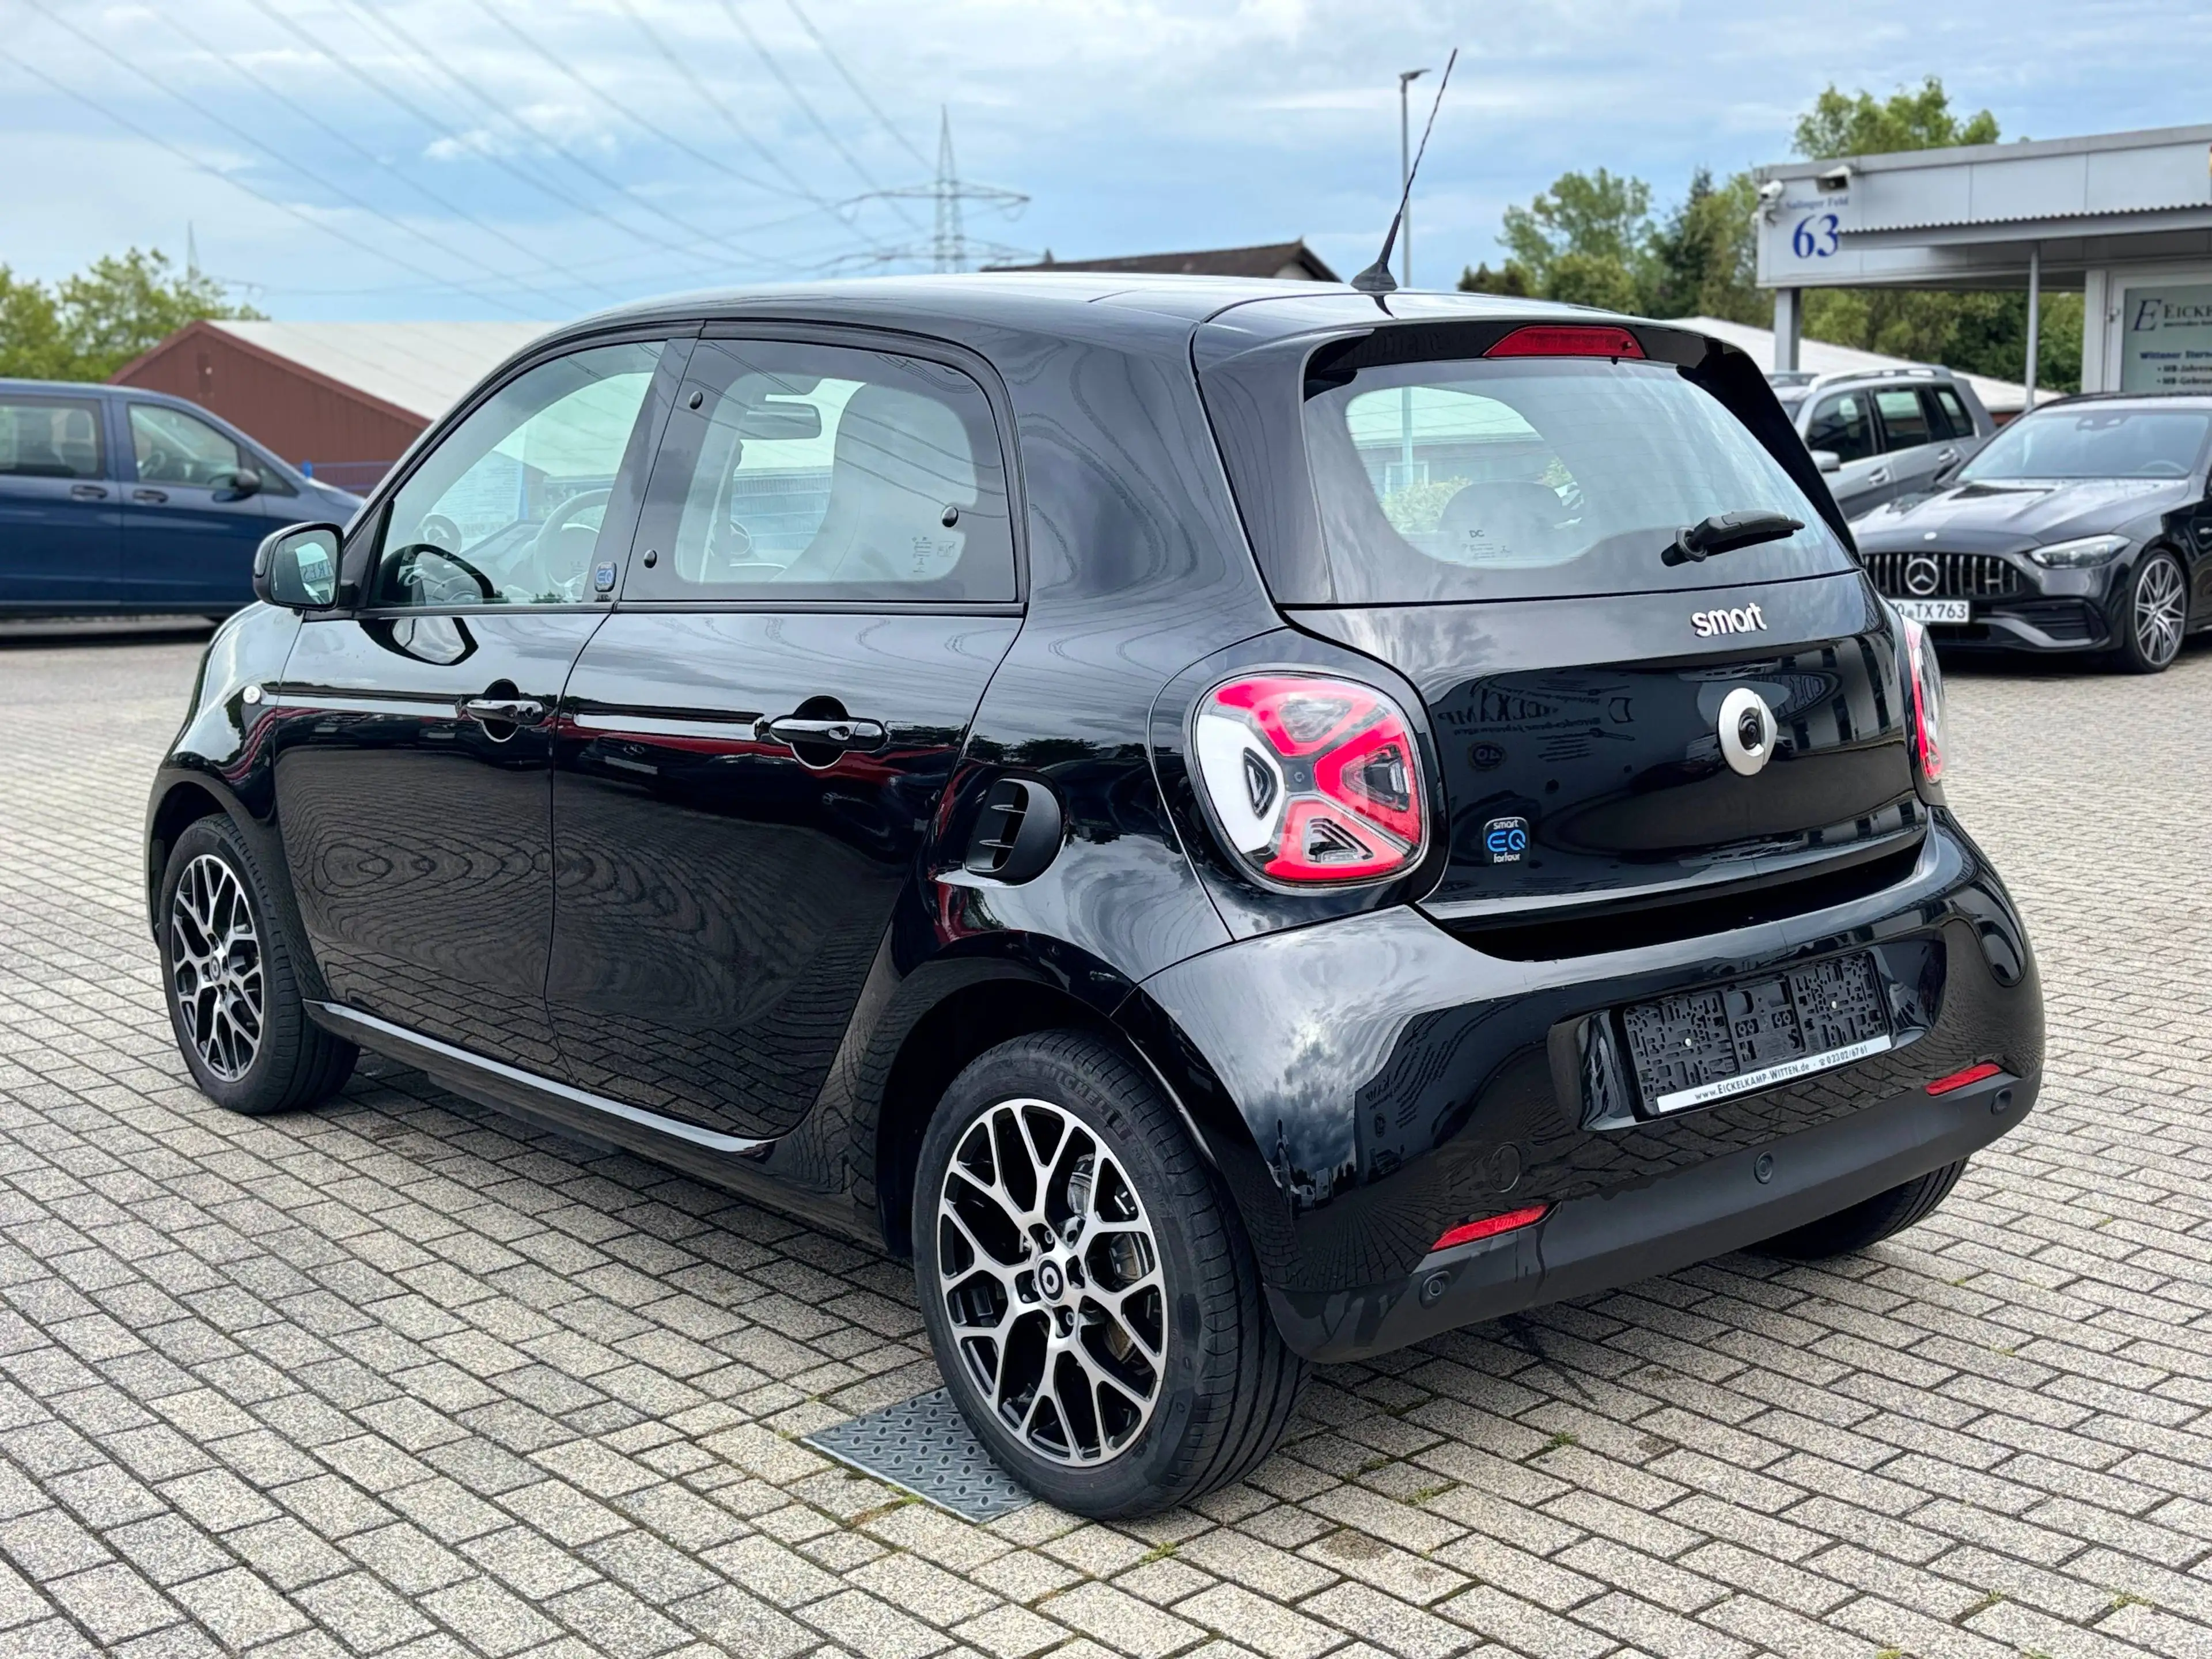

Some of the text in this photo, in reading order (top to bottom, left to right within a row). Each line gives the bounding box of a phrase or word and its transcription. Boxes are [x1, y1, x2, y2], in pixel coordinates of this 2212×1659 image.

[1793, 213, 1839, 259] 63
[2131, 299, 2162, 331] E
[1691, 602, 1768, 638] smart
[1936, 604, 1966, 619] 763
[1493, 819, 1520, 830] smart
[1487, 829, 1526, 852] EQ
[1493, 852, 1521, 863] forfour
[1041, 1065, 1129, 1136] MICHELIN
